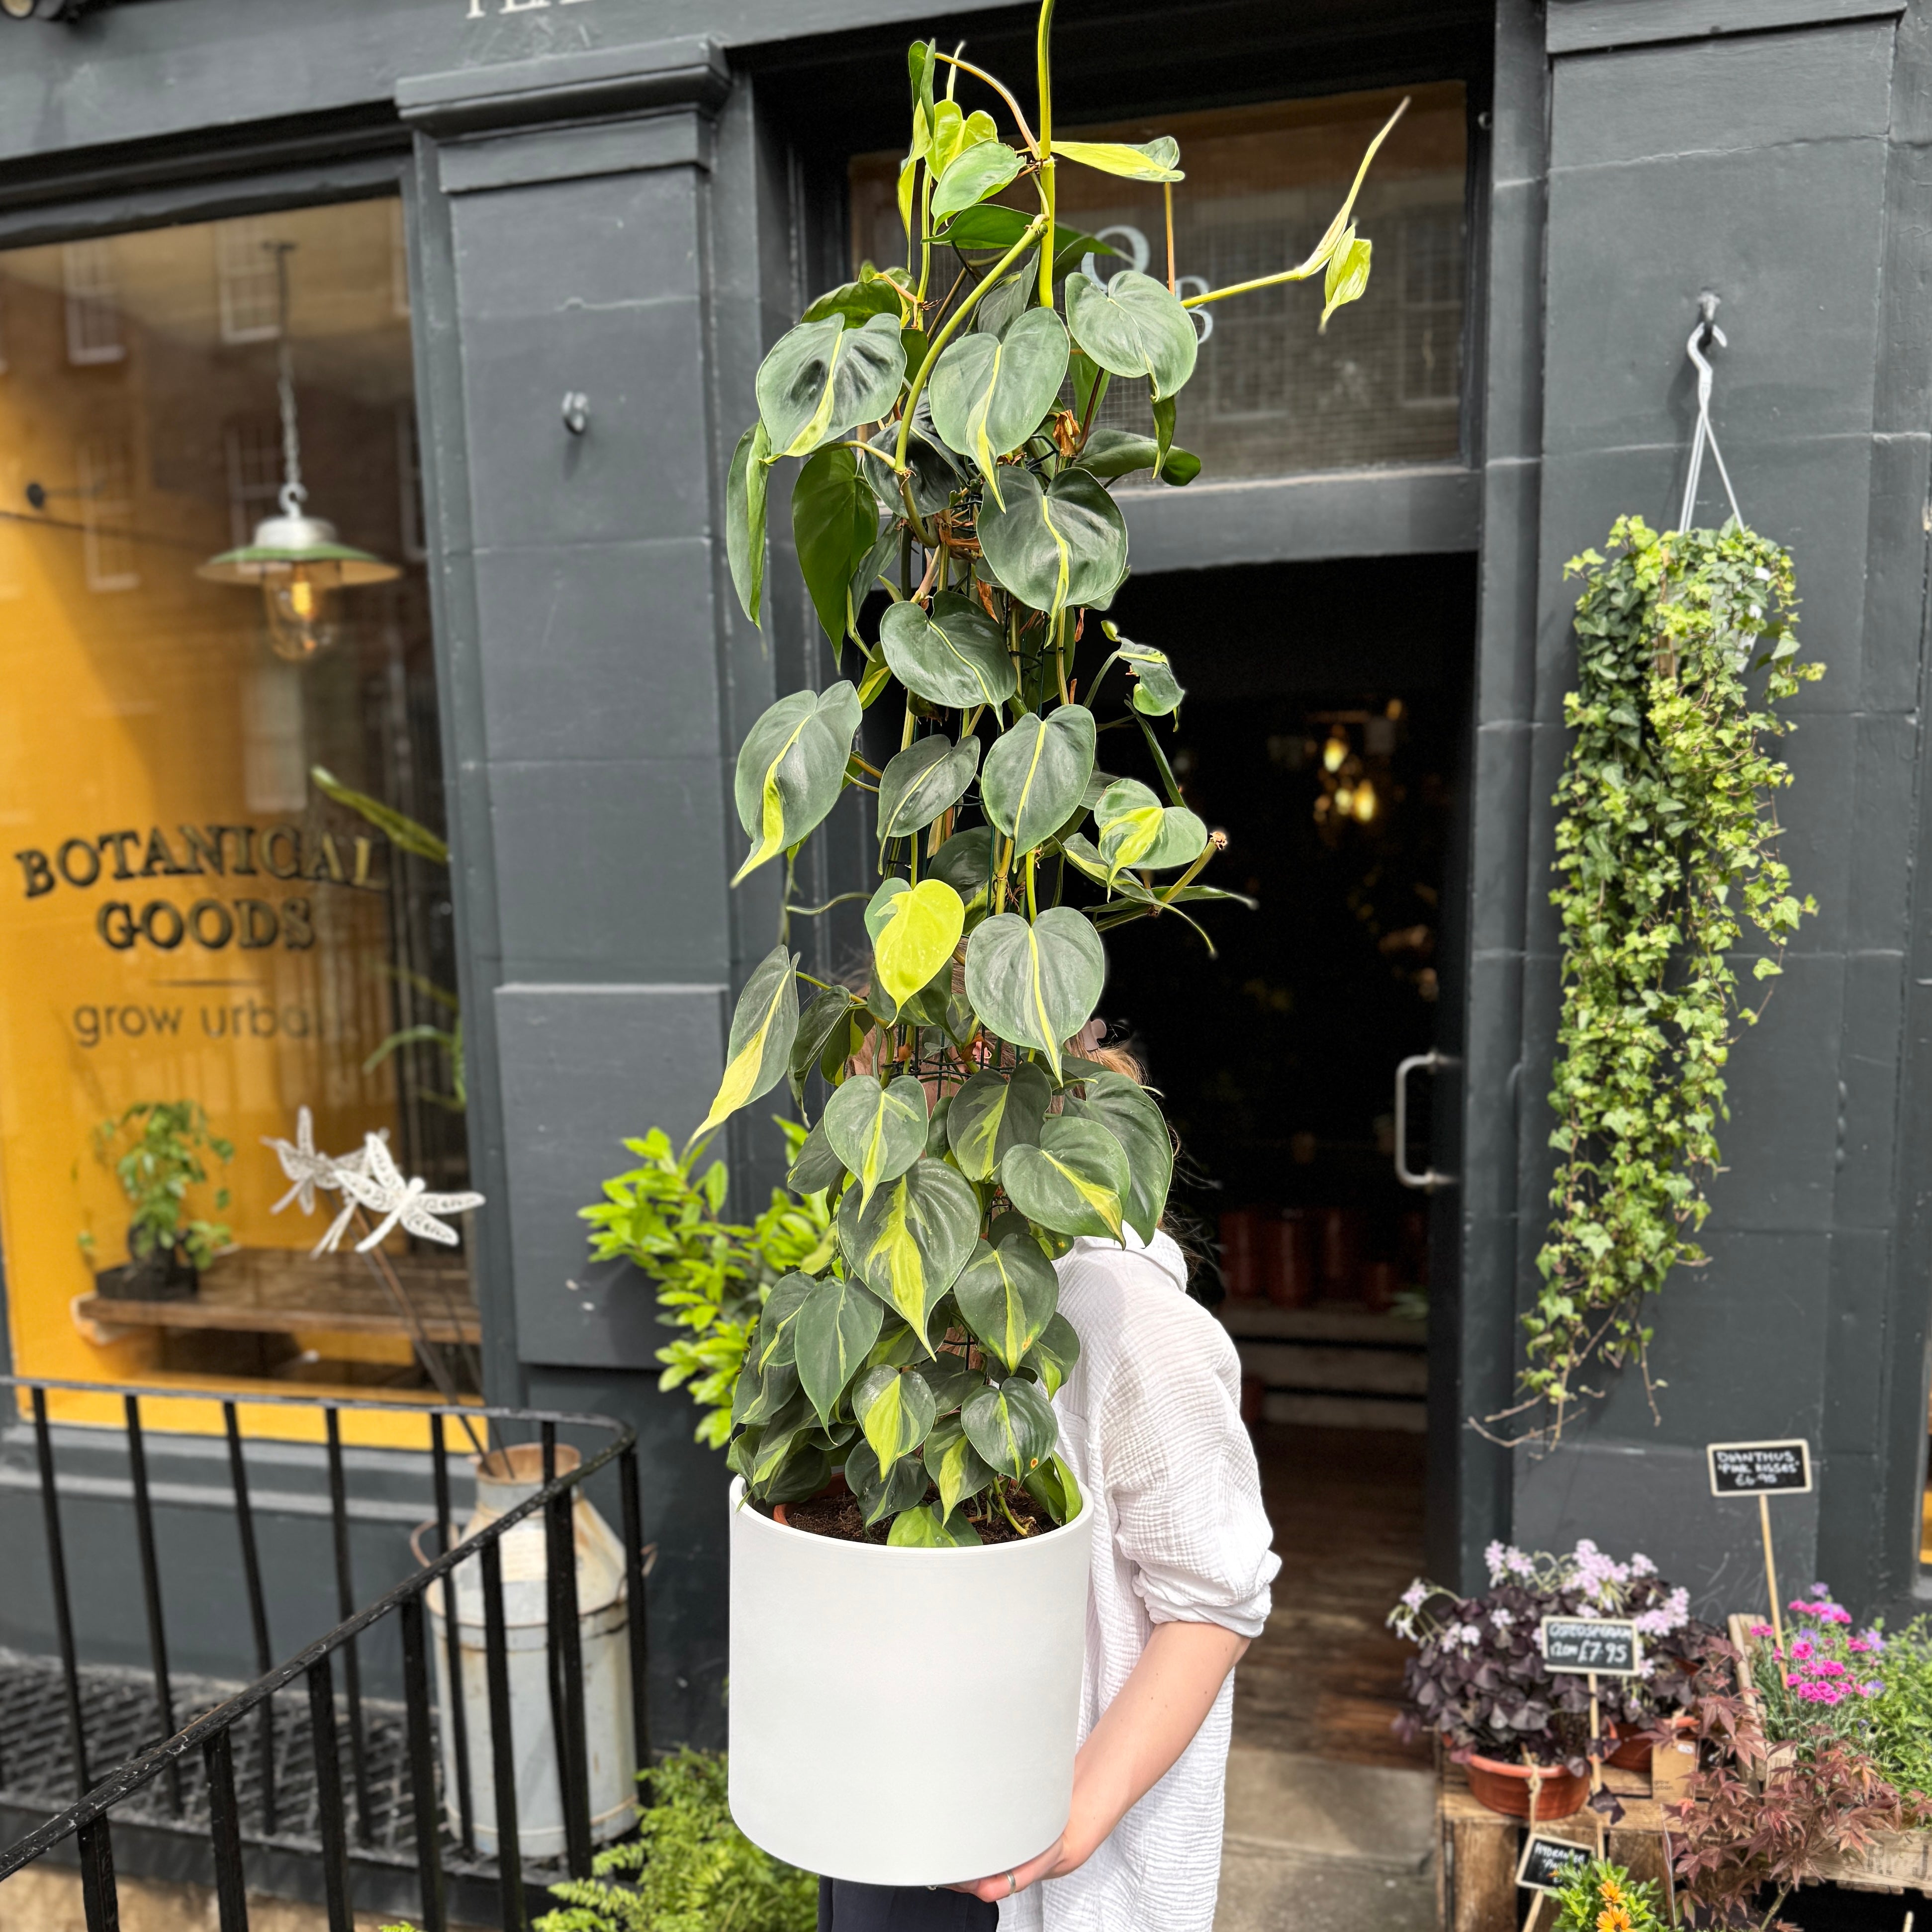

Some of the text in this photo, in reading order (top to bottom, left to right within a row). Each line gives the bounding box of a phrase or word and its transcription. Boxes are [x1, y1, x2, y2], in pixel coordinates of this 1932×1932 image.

[14, 823, 389, 898] BOTANICAL
[96, 898, 316, 950] GOODS
[73, 1004, 183, 1048] grow
